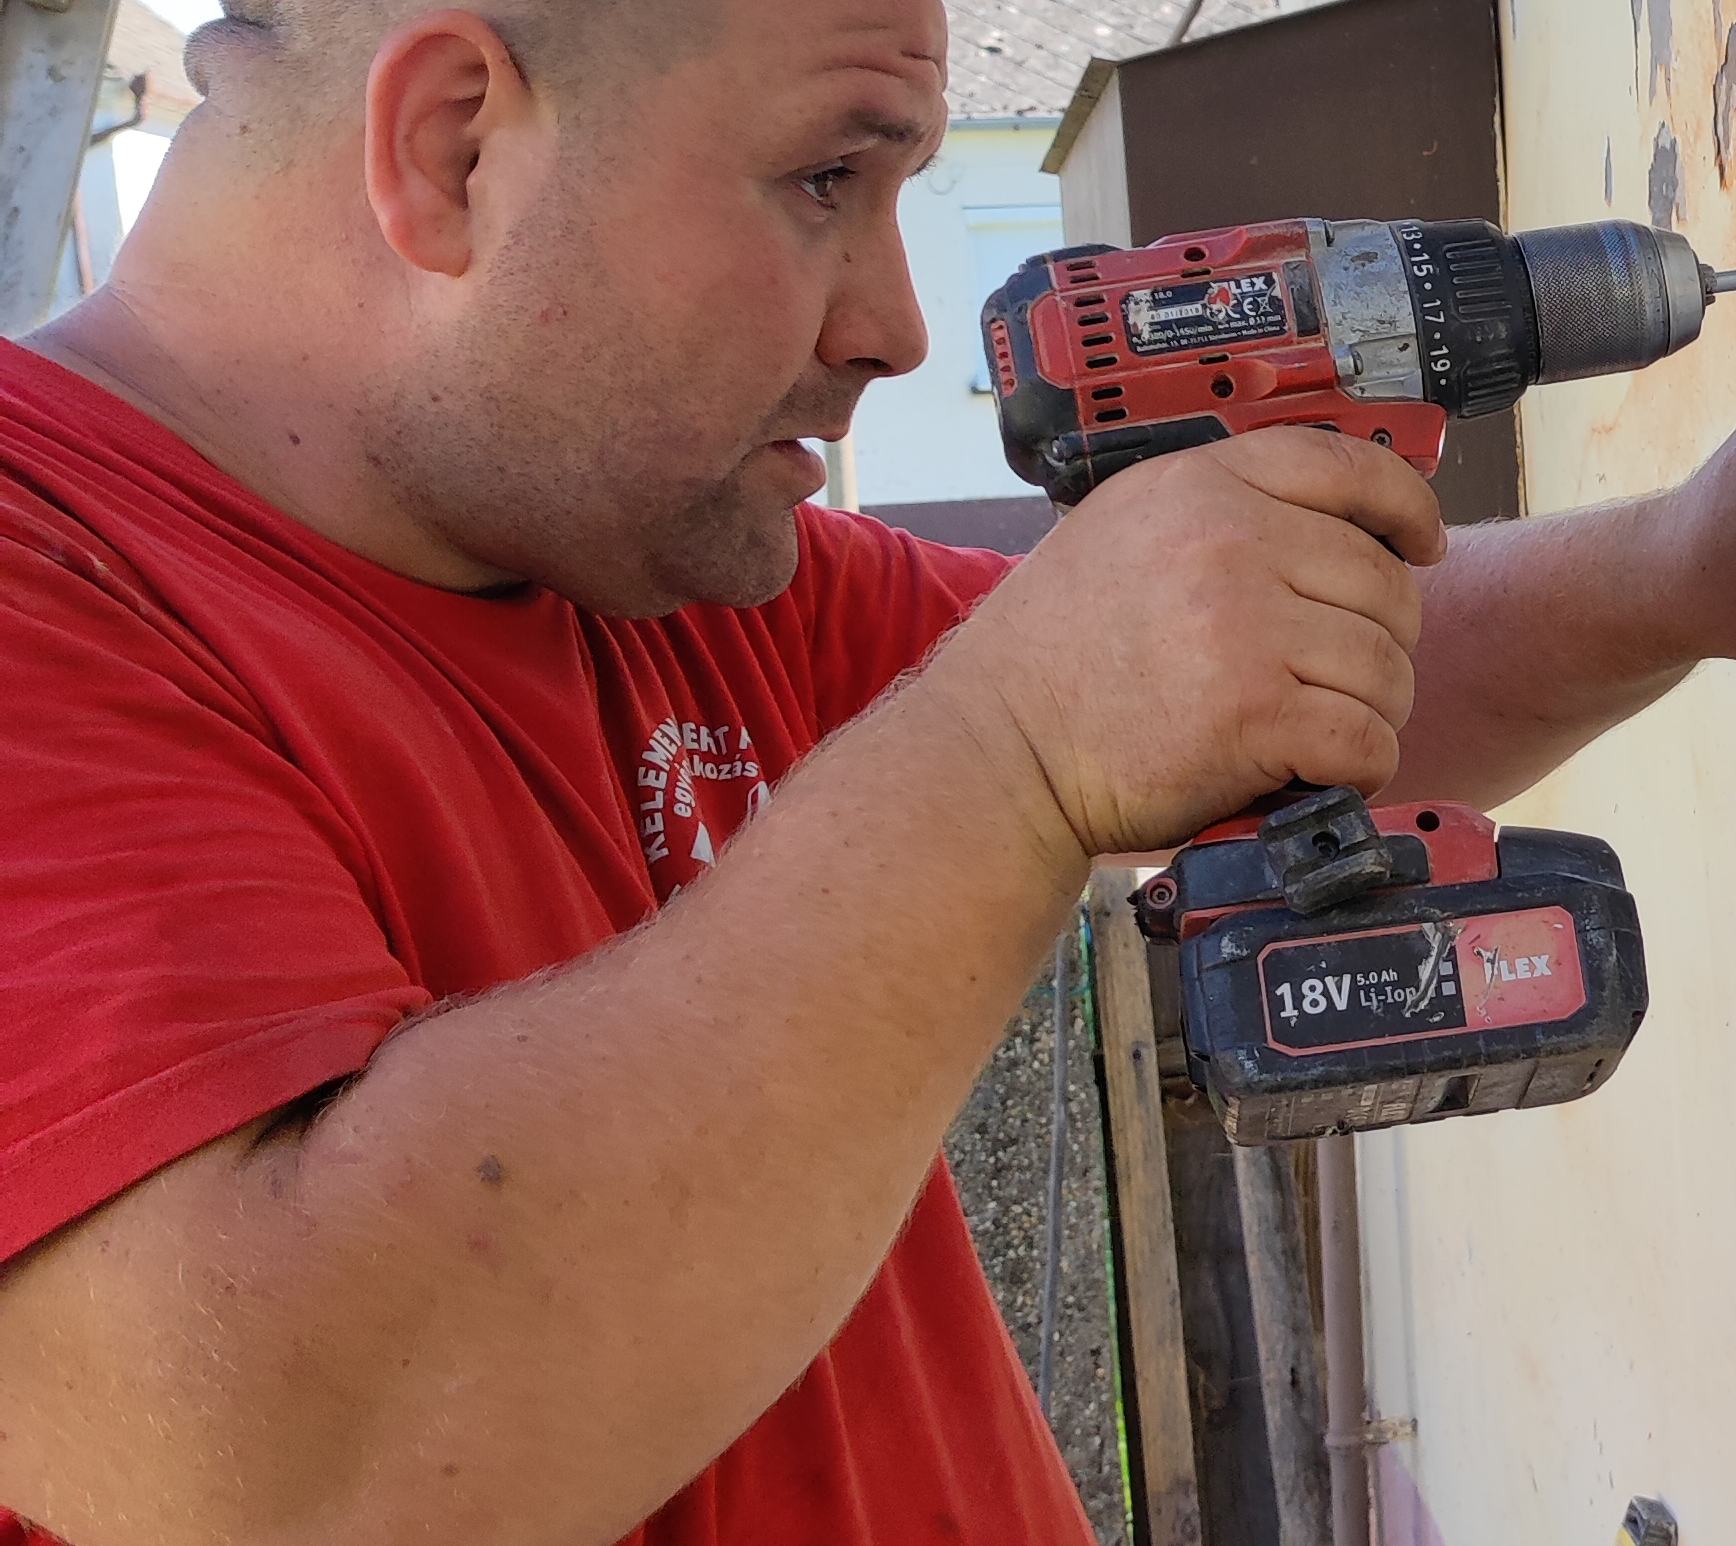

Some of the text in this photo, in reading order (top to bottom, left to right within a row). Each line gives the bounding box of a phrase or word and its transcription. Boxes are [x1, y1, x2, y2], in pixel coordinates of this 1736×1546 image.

[1410, 253, 1434, 277] 15
[1422, 299, 1445, 323] 17
[1430, 345, 1451, 372] 19
[638, 717, 682, 864] KELEMEN
[1275, 969, 1398, 1018] 18V 5.0 Ah
